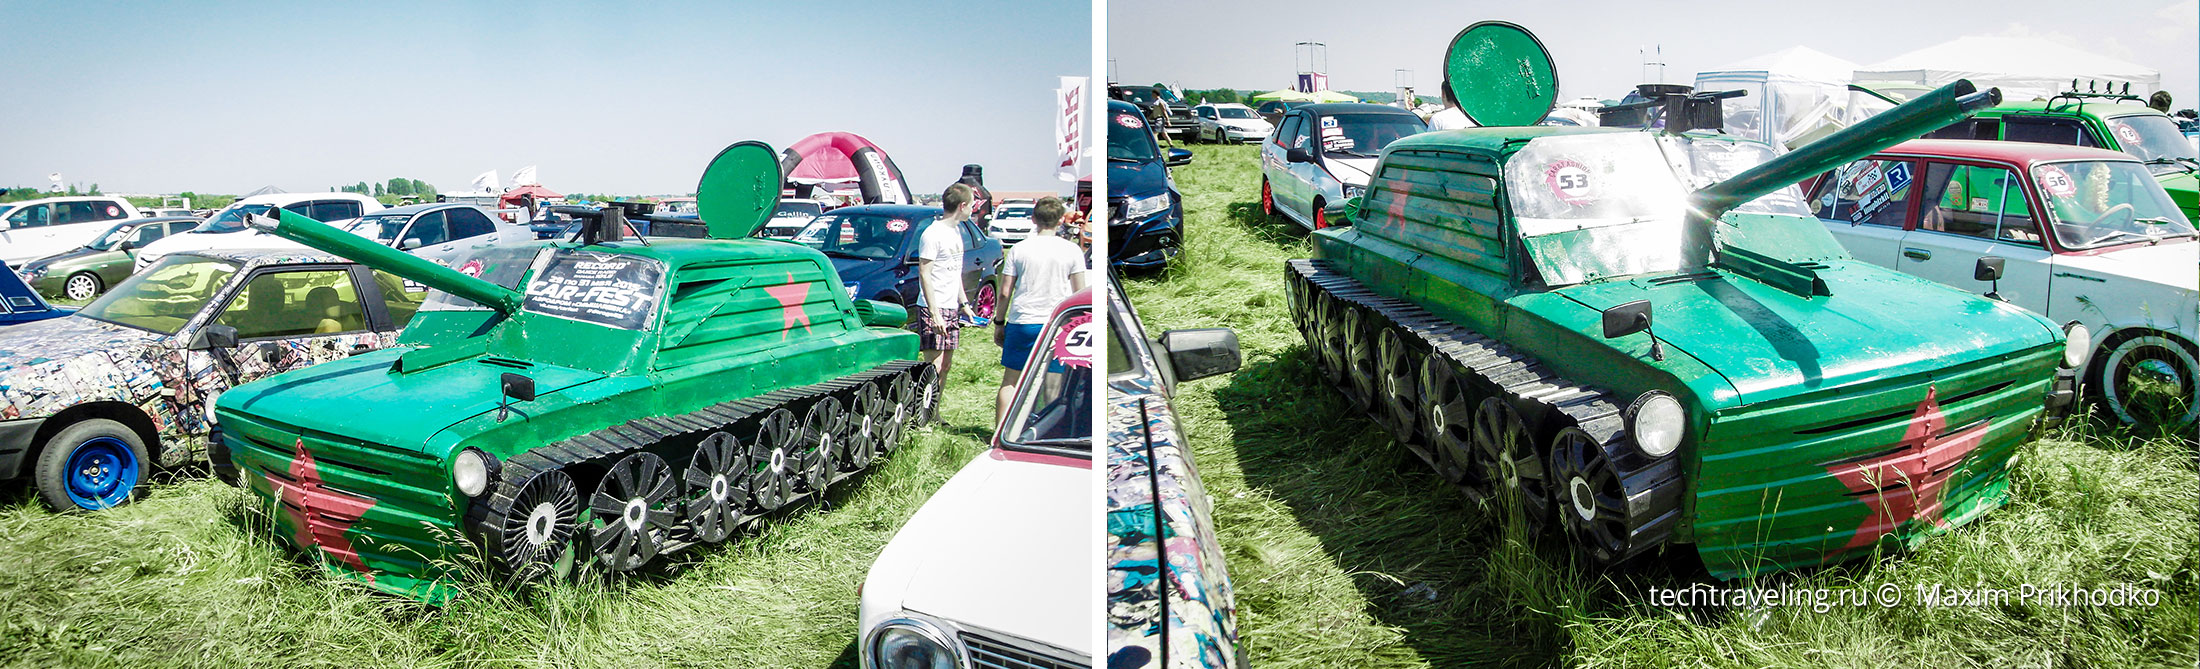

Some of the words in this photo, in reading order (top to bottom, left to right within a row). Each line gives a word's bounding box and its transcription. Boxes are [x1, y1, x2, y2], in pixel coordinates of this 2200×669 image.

[1560, 174, 1588, 189] 53
[2049, 176, 2066, 187] 56
[573, 261, 626, 270] RECORD
[527, 281, 653, 312] CAR-FEST
